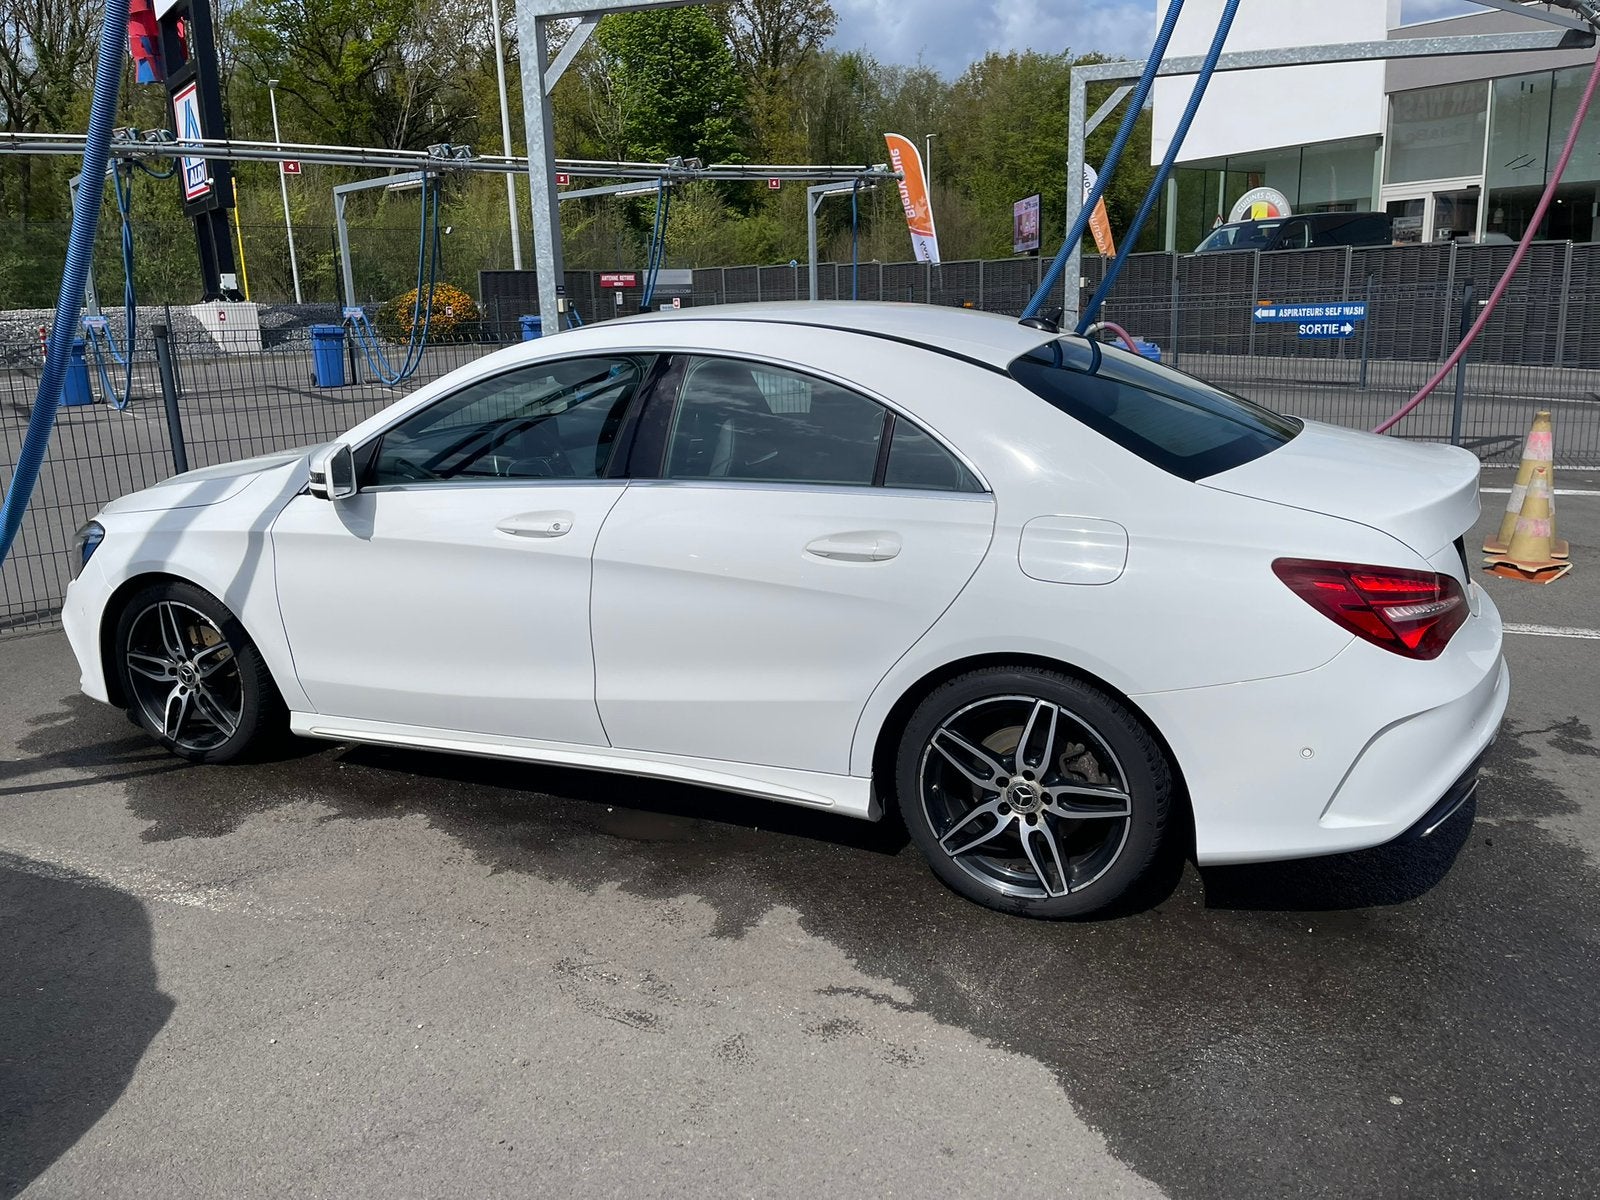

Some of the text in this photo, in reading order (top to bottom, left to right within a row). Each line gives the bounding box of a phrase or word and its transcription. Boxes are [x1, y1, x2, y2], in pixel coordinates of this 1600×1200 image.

[190, 164, 205, 186] ALDI
[1237, 192, 1283, 213] CUISINES DOVY
[1279, 306, 1364, 317] ASPIRATEURS SELF WASH
[1299, 323, 1340, 335] SORTIE
